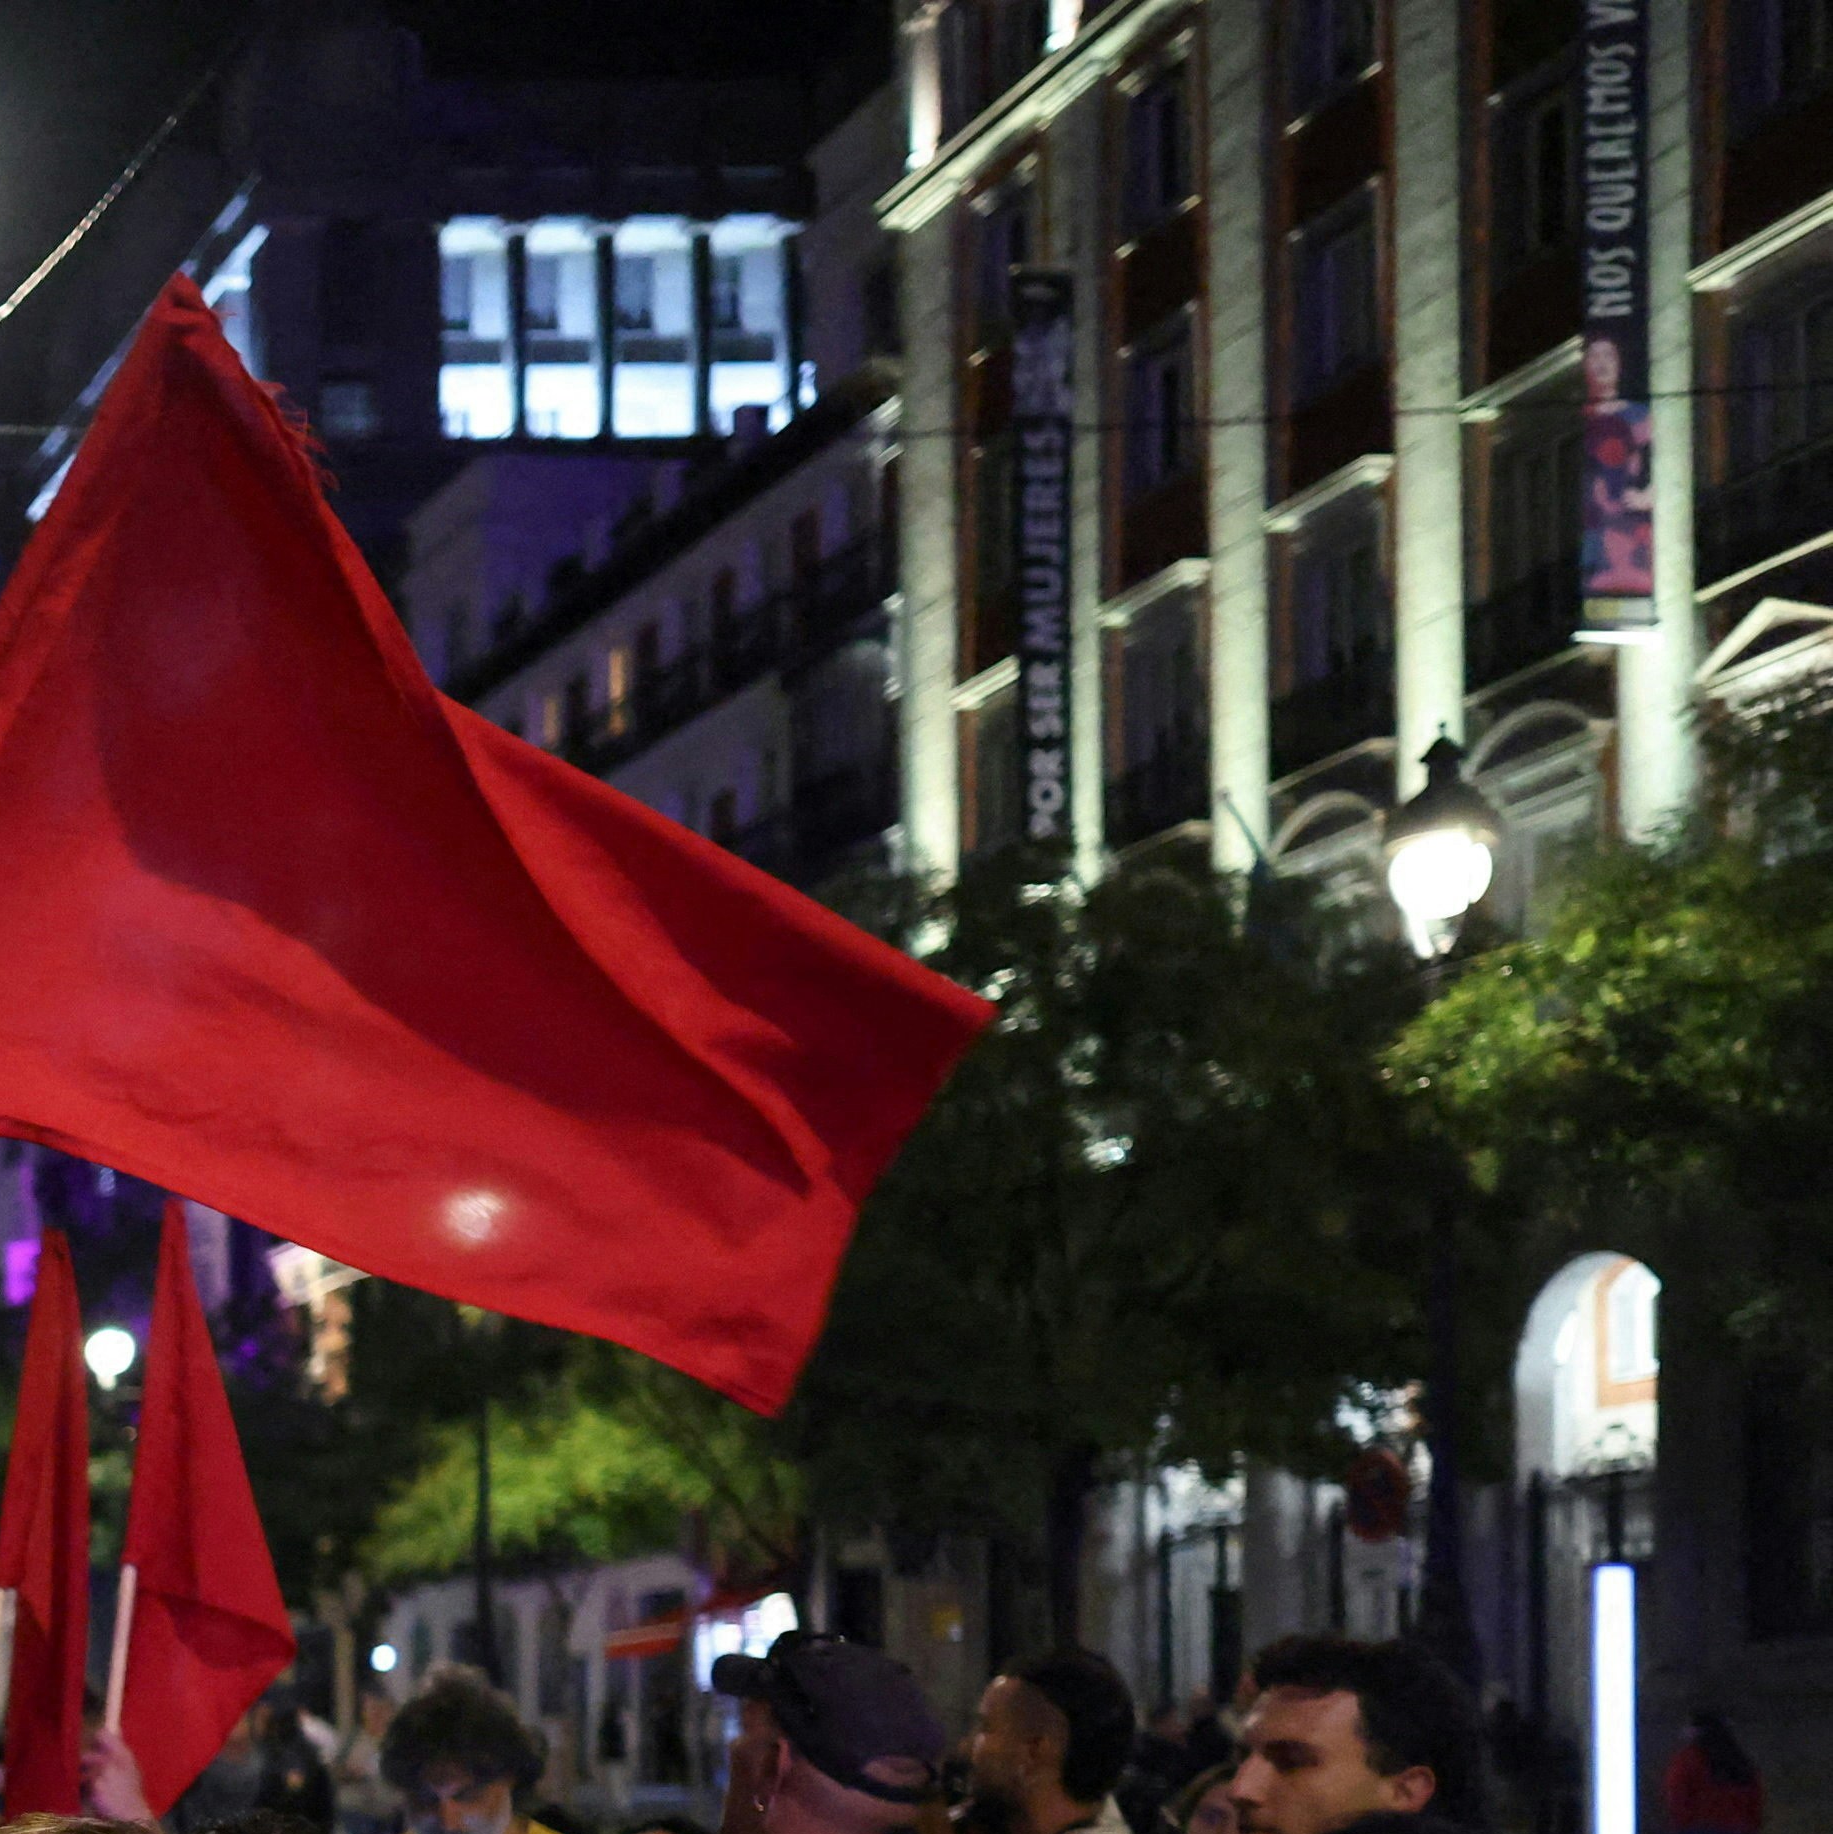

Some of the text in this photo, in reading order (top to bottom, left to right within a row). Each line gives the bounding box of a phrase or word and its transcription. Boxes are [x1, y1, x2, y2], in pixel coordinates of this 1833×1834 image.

[1584, 41, 1638, 232] QUEREMOS
[1585, 245, 1637, 318] NOS
[1022, 430, 1065, 653] MUJERES
